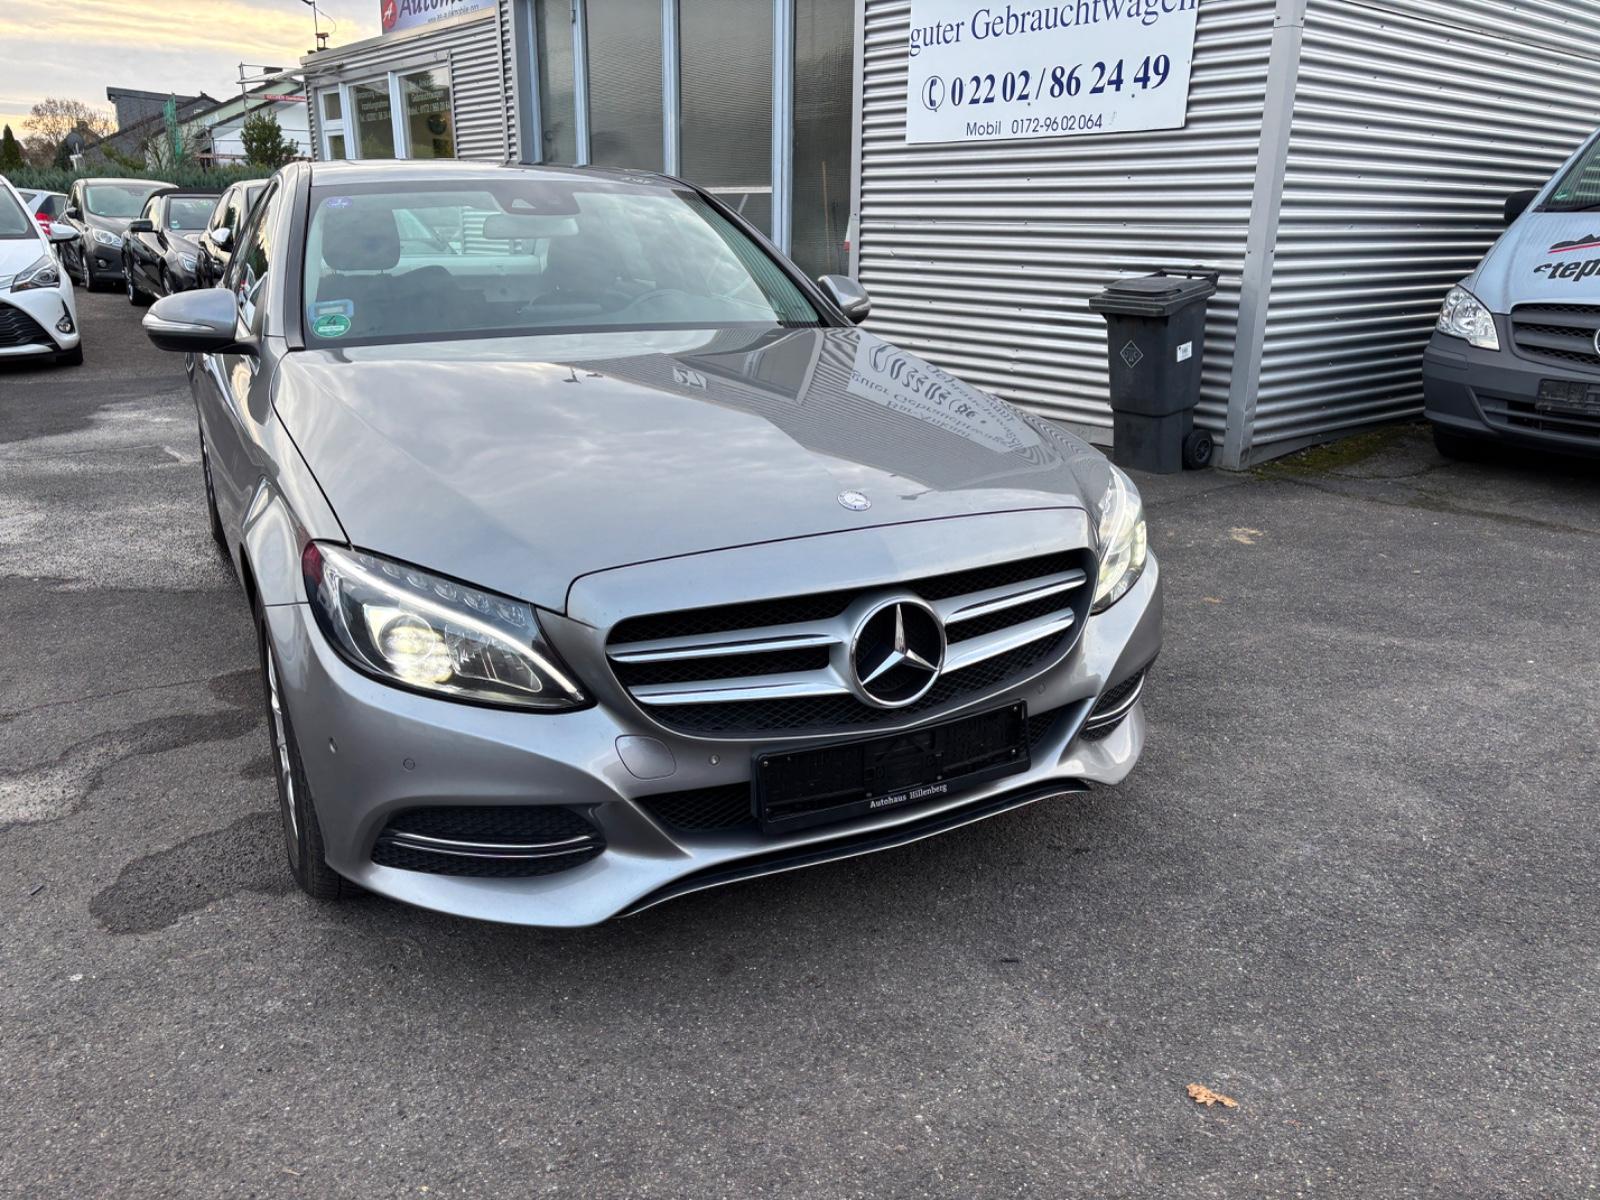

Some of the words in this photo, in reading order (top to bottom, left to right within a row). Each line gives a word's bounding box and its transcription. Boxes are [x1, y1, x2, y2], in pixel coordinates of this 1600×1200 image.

[399, 0, 467, 18] Auto
[909, 19, 965, 57] guter
[966, 120, 1001, 137] Mobil
[1533, 258, 1600, 282] Step
[870, 794, 907, 809] Autohaus
